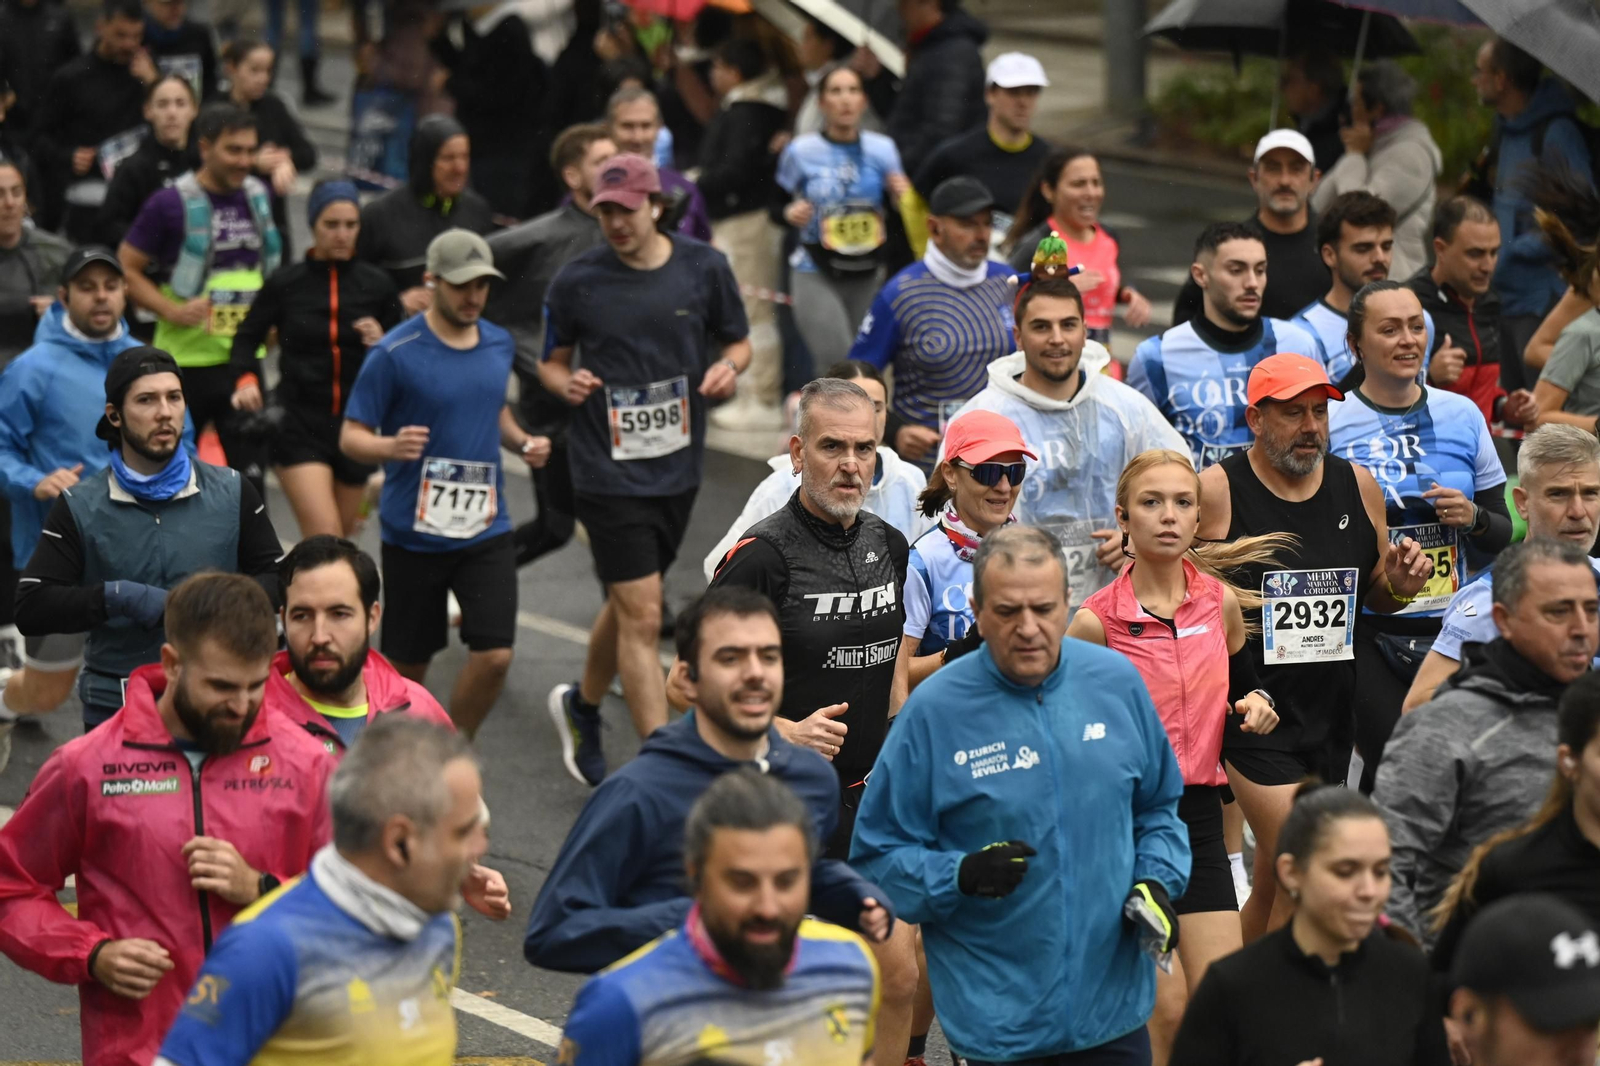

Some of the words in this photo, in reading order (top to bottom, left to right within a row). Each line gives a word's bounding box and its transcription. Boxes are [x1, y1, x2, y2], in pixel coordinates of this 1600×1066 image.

[622, 404, 680, 434] 5998
[432, 485, 487, 513] 7177
[1415, 525, 1442, 535] MEDIA
[1420, 540, 1445, 549] RDOBA
[1306, 571, 1338, 581] MEDIA
[1306, 580, 1339, 588] MARATÓN
[812, 614, 852, 622] BIKE
[862, 604, 897, 620] TEAM
[1274, 599, 1346, 630] 2932
[1301, 635, 1324, 643] ANDRES
[968, 741, 1006, 759] ZURICH
[103, 762, 177, 775] GIVOVA
[970, 753, 1008, 770] MARATÓN
[971, 762, 1011, 779] SEVILLA
